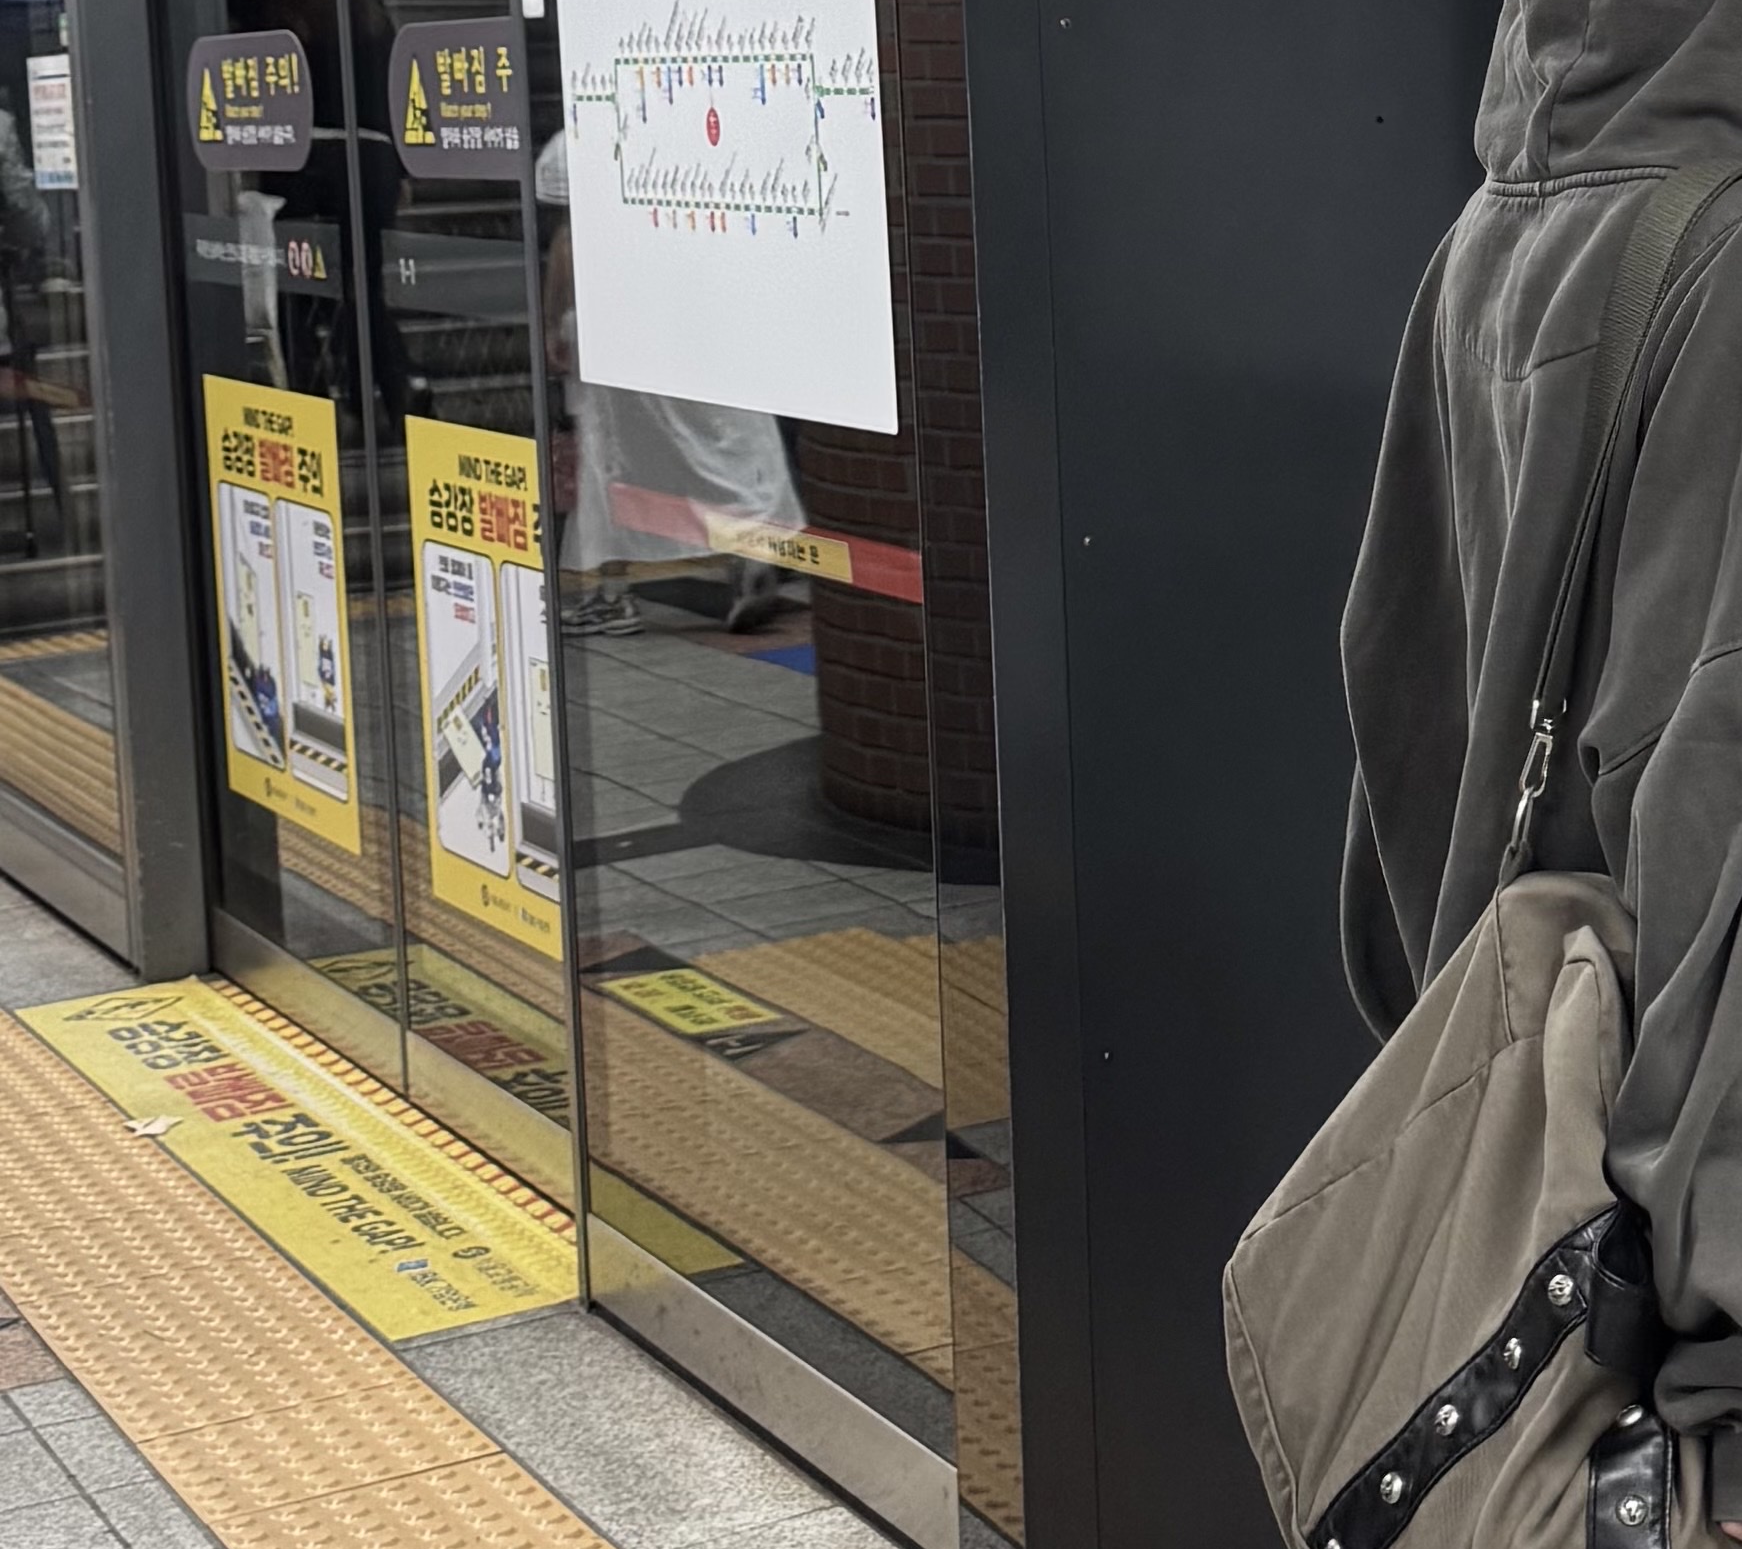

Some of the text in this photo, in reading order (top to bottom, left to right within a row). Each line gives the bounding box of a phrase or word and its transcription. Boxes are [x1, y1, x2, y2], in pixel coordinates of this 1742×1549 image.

[222, 428, 323, 498] 승강장 발빠짐 주의
[429, 478, 474, 537] 승강장
[478, 490, 528, 552] 발빠짐
[107, 1019, 231, 1070] 승강장
[164, 1061, 295, 1123] 발빠짐
[281, 1164, 350, 1198] MIND
[320, 1194, 384, 1224] THE
